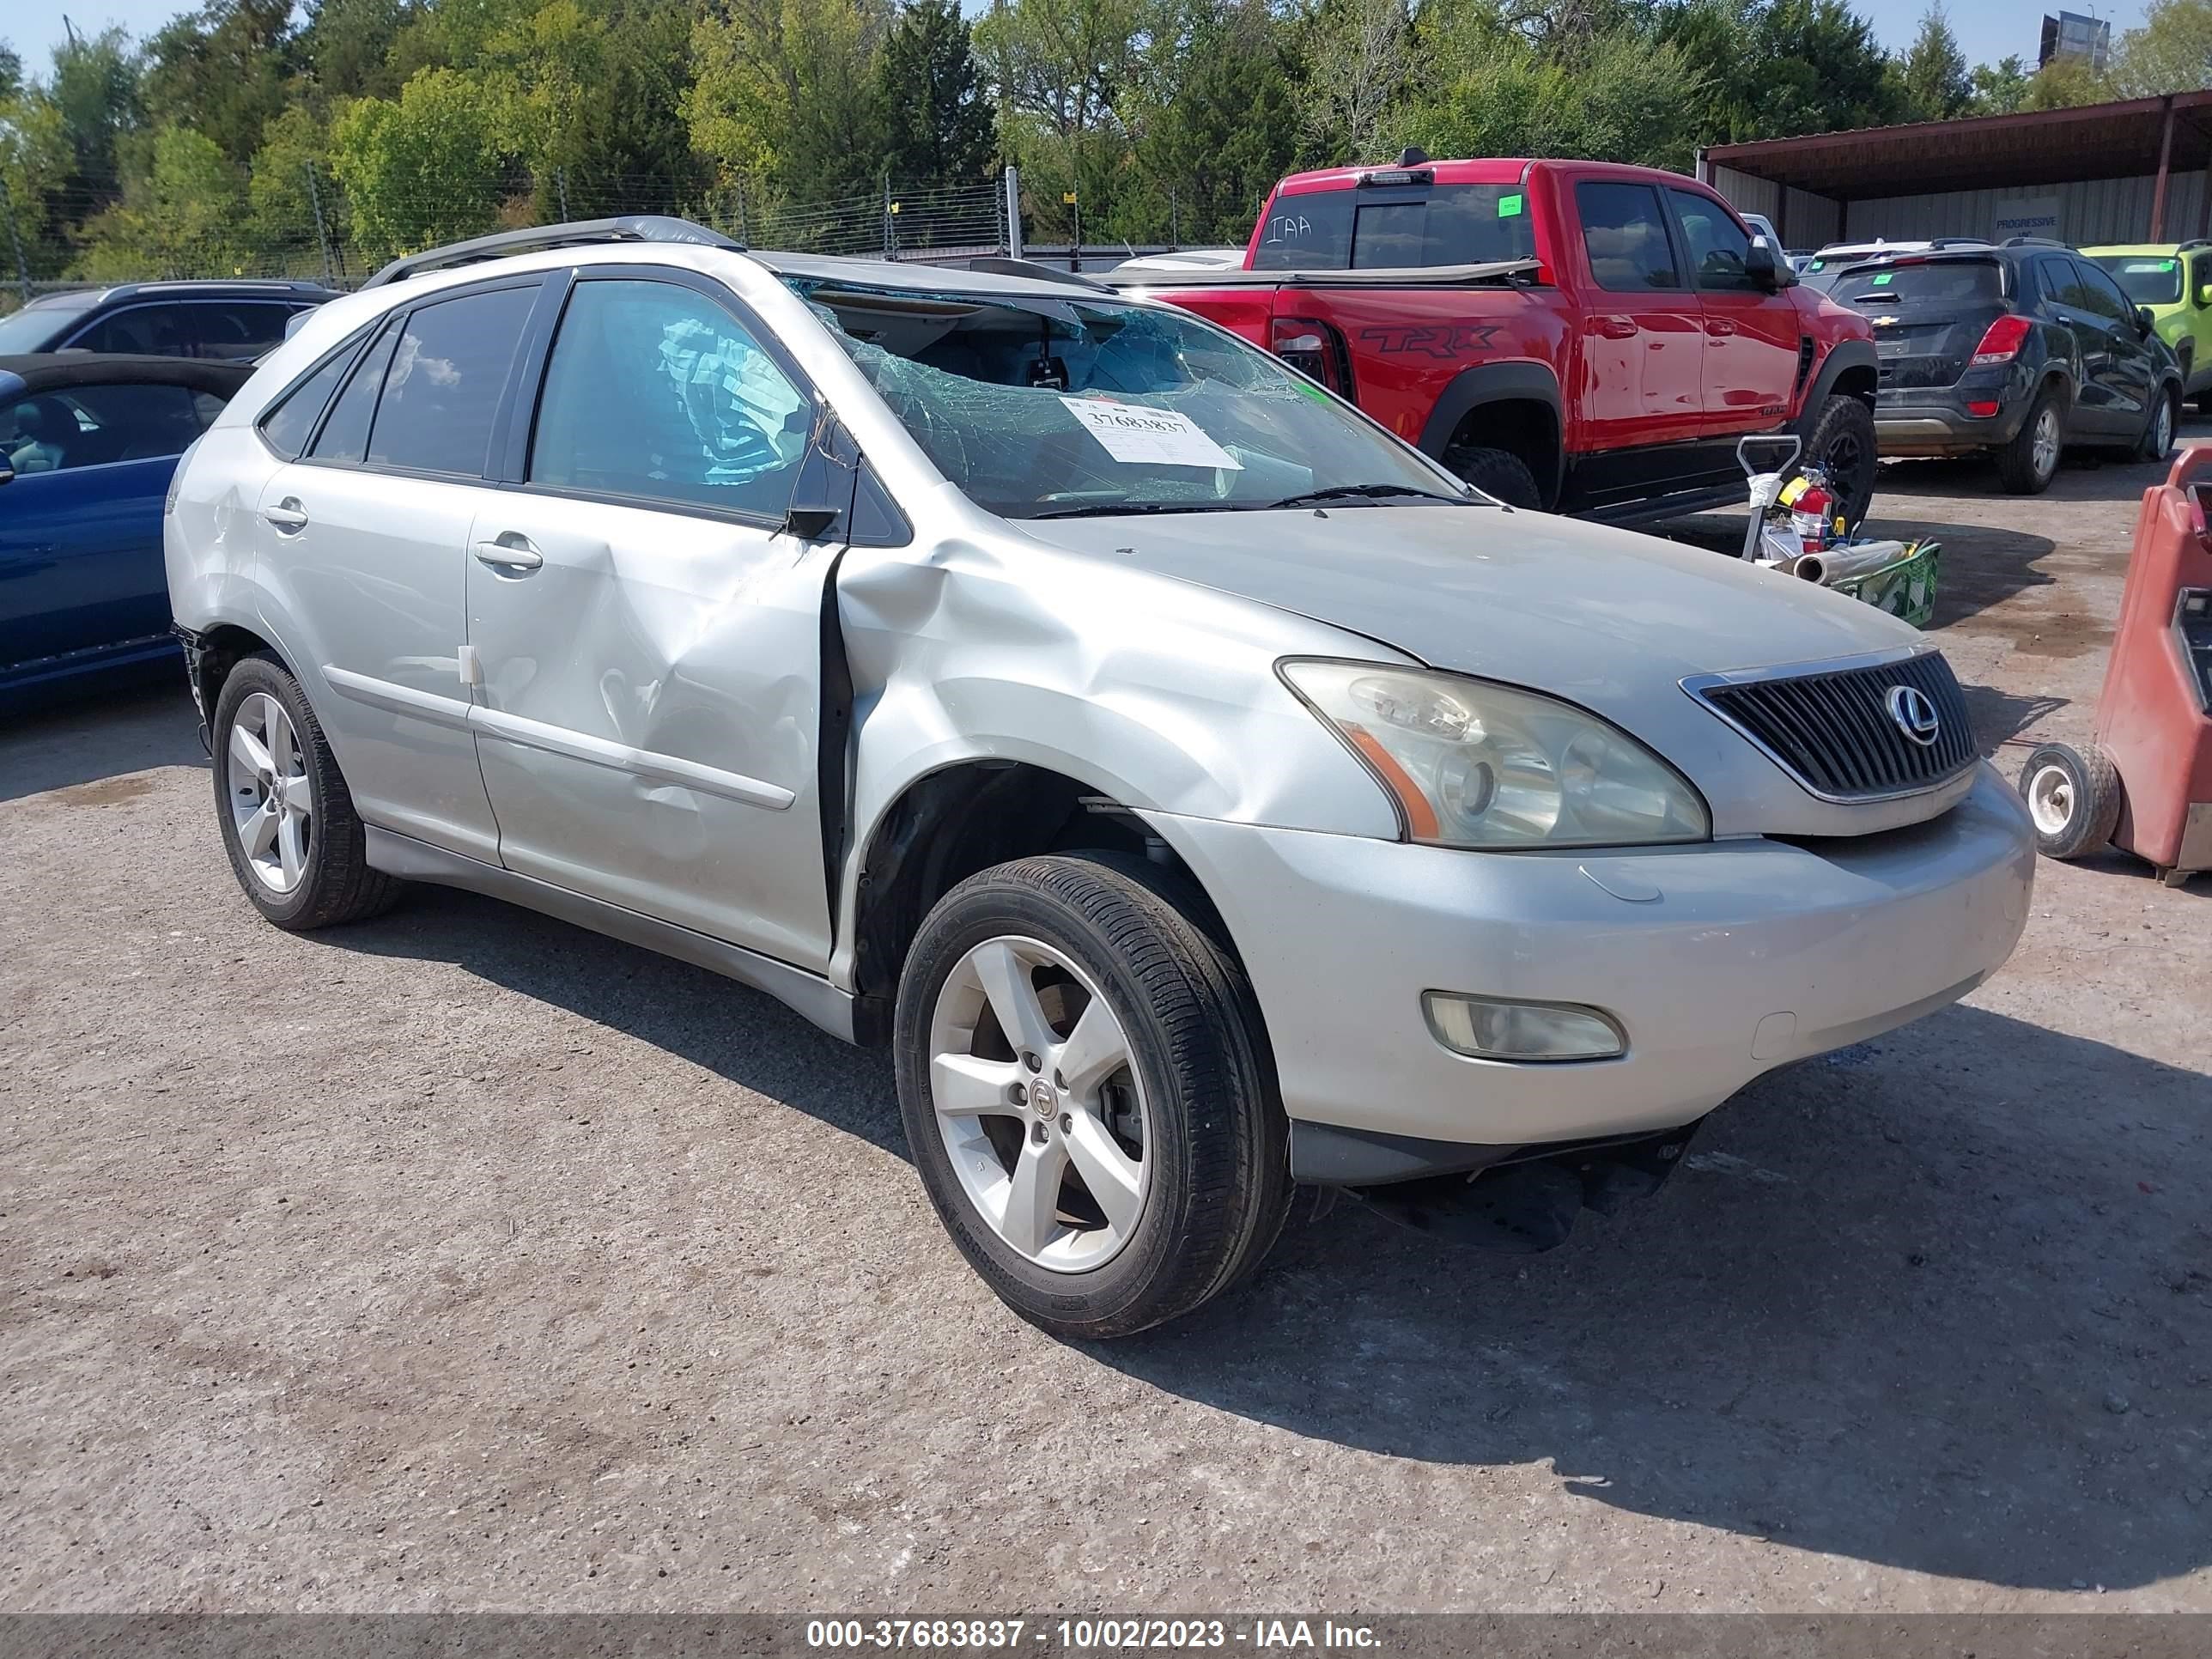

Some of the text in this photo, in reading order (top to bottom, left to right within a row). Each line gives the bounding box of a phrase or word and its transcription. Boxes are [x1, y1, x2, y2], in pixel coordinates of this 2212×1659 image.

[1266, 216, 1312, 244] IAA
[1996, 216, 2057, 230] PROGRESSIVE
[1087, 412, 1187, 434] 37683837
